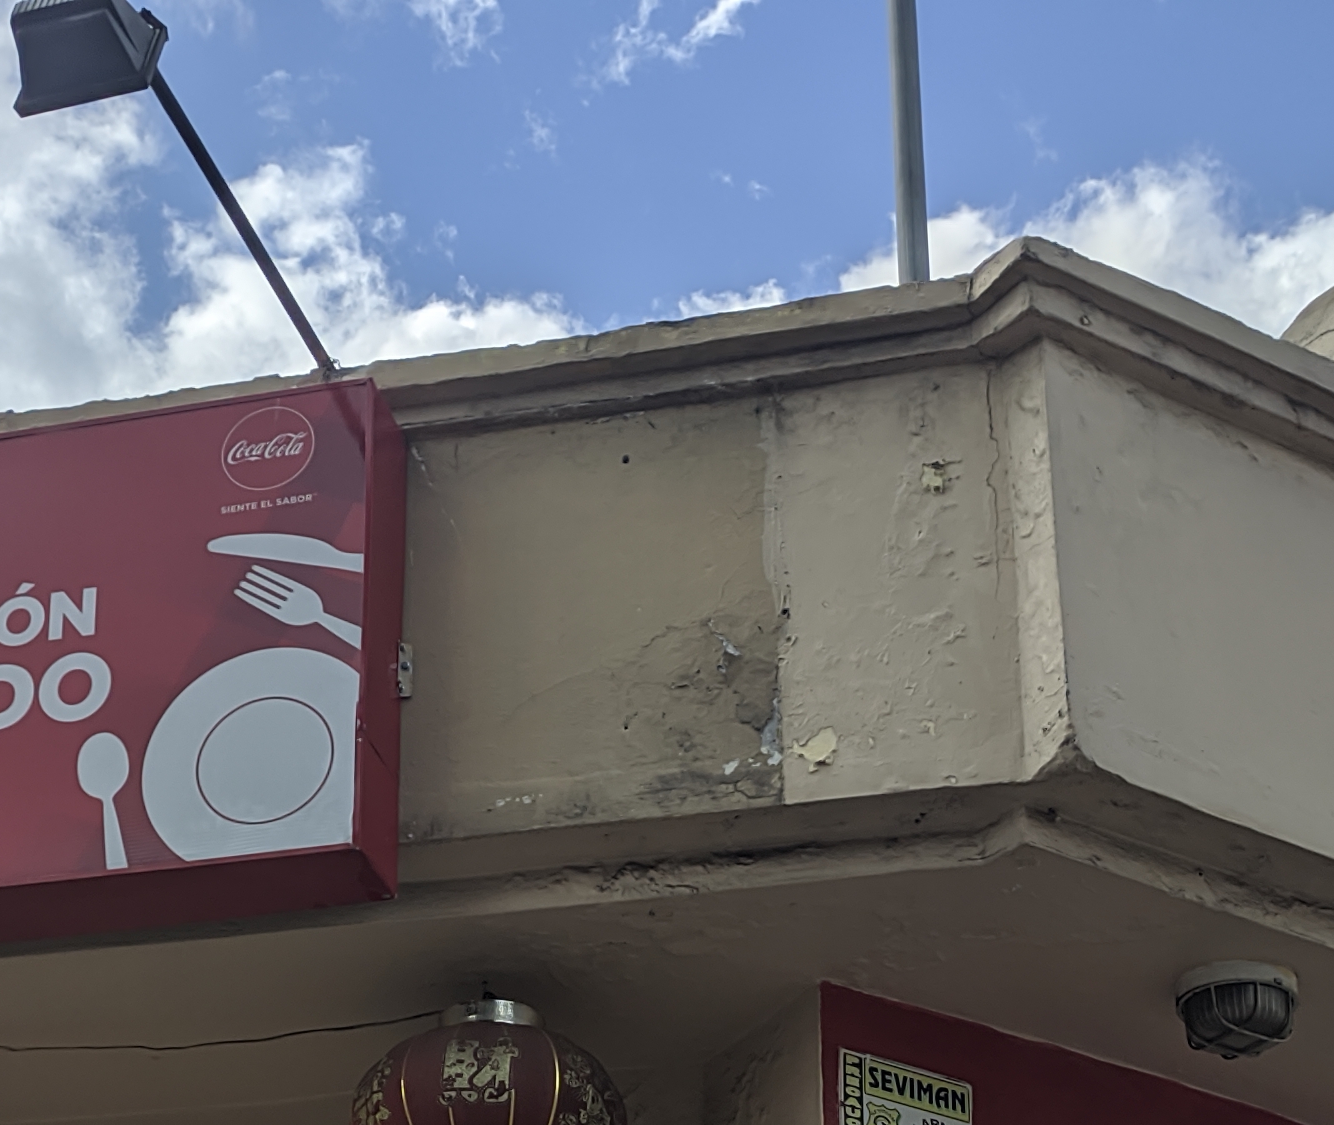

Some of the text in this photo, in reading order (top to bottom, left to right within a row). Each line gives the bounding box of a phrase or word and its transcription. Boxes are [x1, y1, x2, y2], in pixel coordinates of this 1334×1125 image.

[220, 493, 313, 515] SIENTE EL SABOR
[868, 1066, 967, 1114] SEVIMAN
